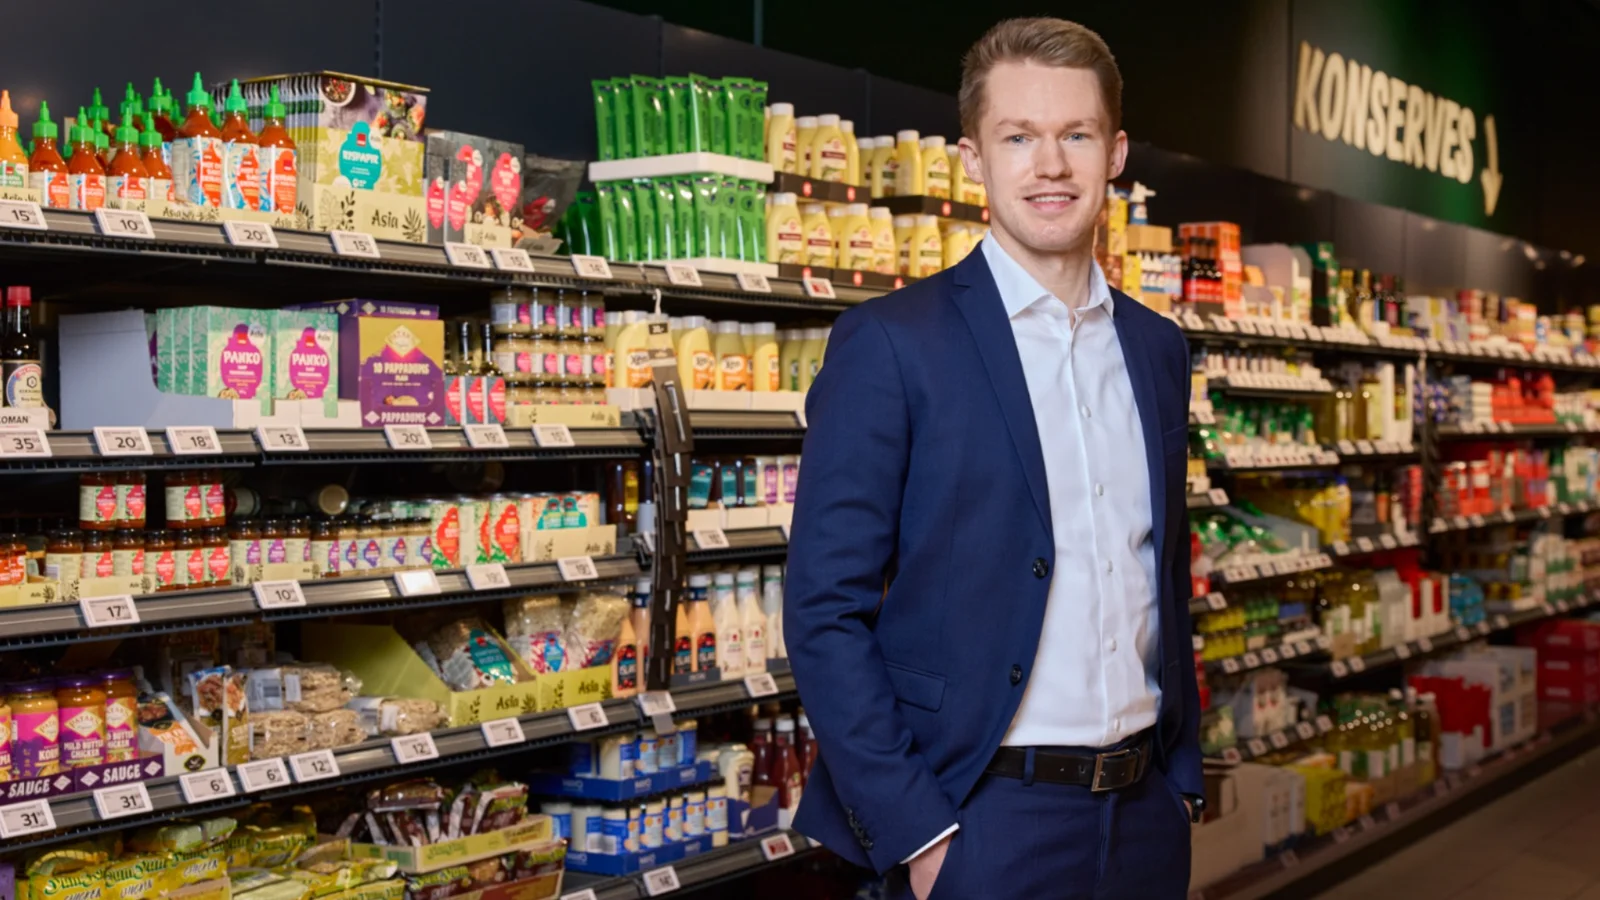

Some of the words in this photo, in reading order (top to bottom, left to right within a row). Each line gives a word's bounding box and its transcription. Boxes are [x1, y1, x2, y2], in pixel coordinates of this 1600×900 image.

[1293, 40, 1477, 184] KONSERVES
[371, 208, 399, 229] Asia
[223, 351, 261, 364] PANKO
[292, 353, 328, 367] PANKO
[384, 362, 430, 375] PAPPADUMS
[381, 411, 426, 424] PAPPADUMS
[578, 680, 599, 695] Asia
[496, 694, 519, 710] Asia
[103, 763, 140, 784] SAUCE
[8, 779, 50, 798] SAUCE
